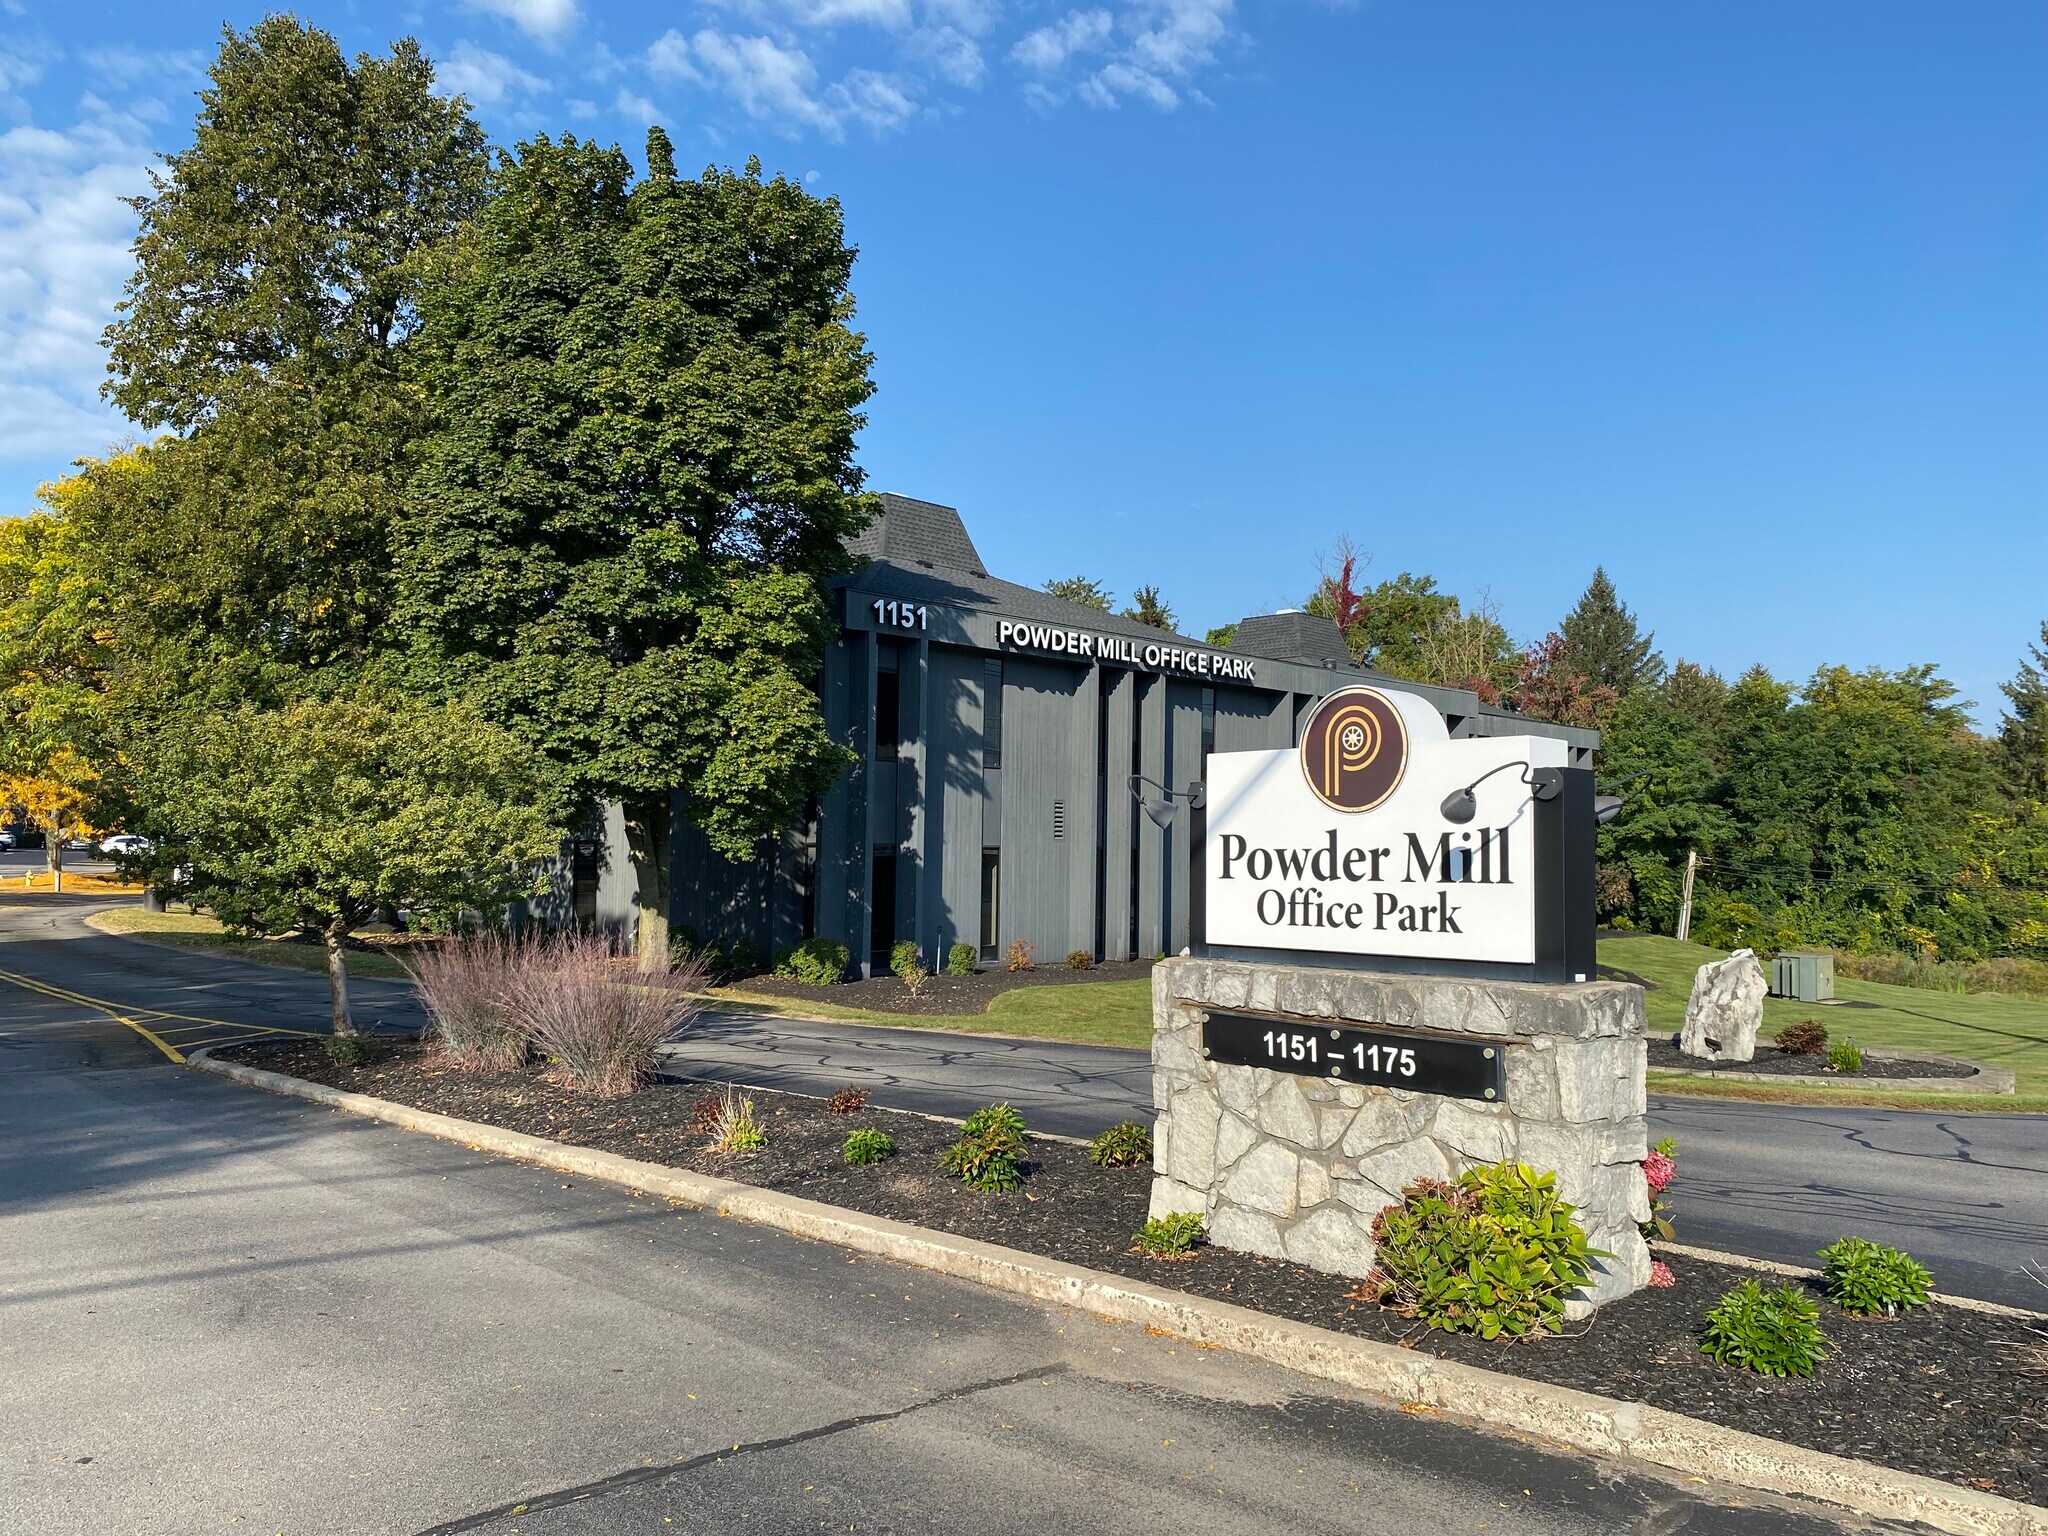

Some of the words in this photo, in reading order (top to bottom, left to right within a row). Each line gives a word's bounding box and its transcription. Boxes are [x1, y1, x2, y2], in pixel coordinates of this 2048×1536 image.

[873, 599, 928, 630] 1151
[999, 620, 1092, 657] POWDER
[1098, 636, 1141, 664] MILL
[1145, 645, 1208, 675] OFFICE
[1213, 655, 1256, 681] PARK
[1218, 828, 1390, 882] Powder
[1403, 827, 1514, 885] Mill
[1256, 887, 1363, 929] Office
[1373, 890, 1464, 934] Park
[1263, 1030, 1318, 1063] 1151
[1353, 1042, 1417, 1077] 1175
